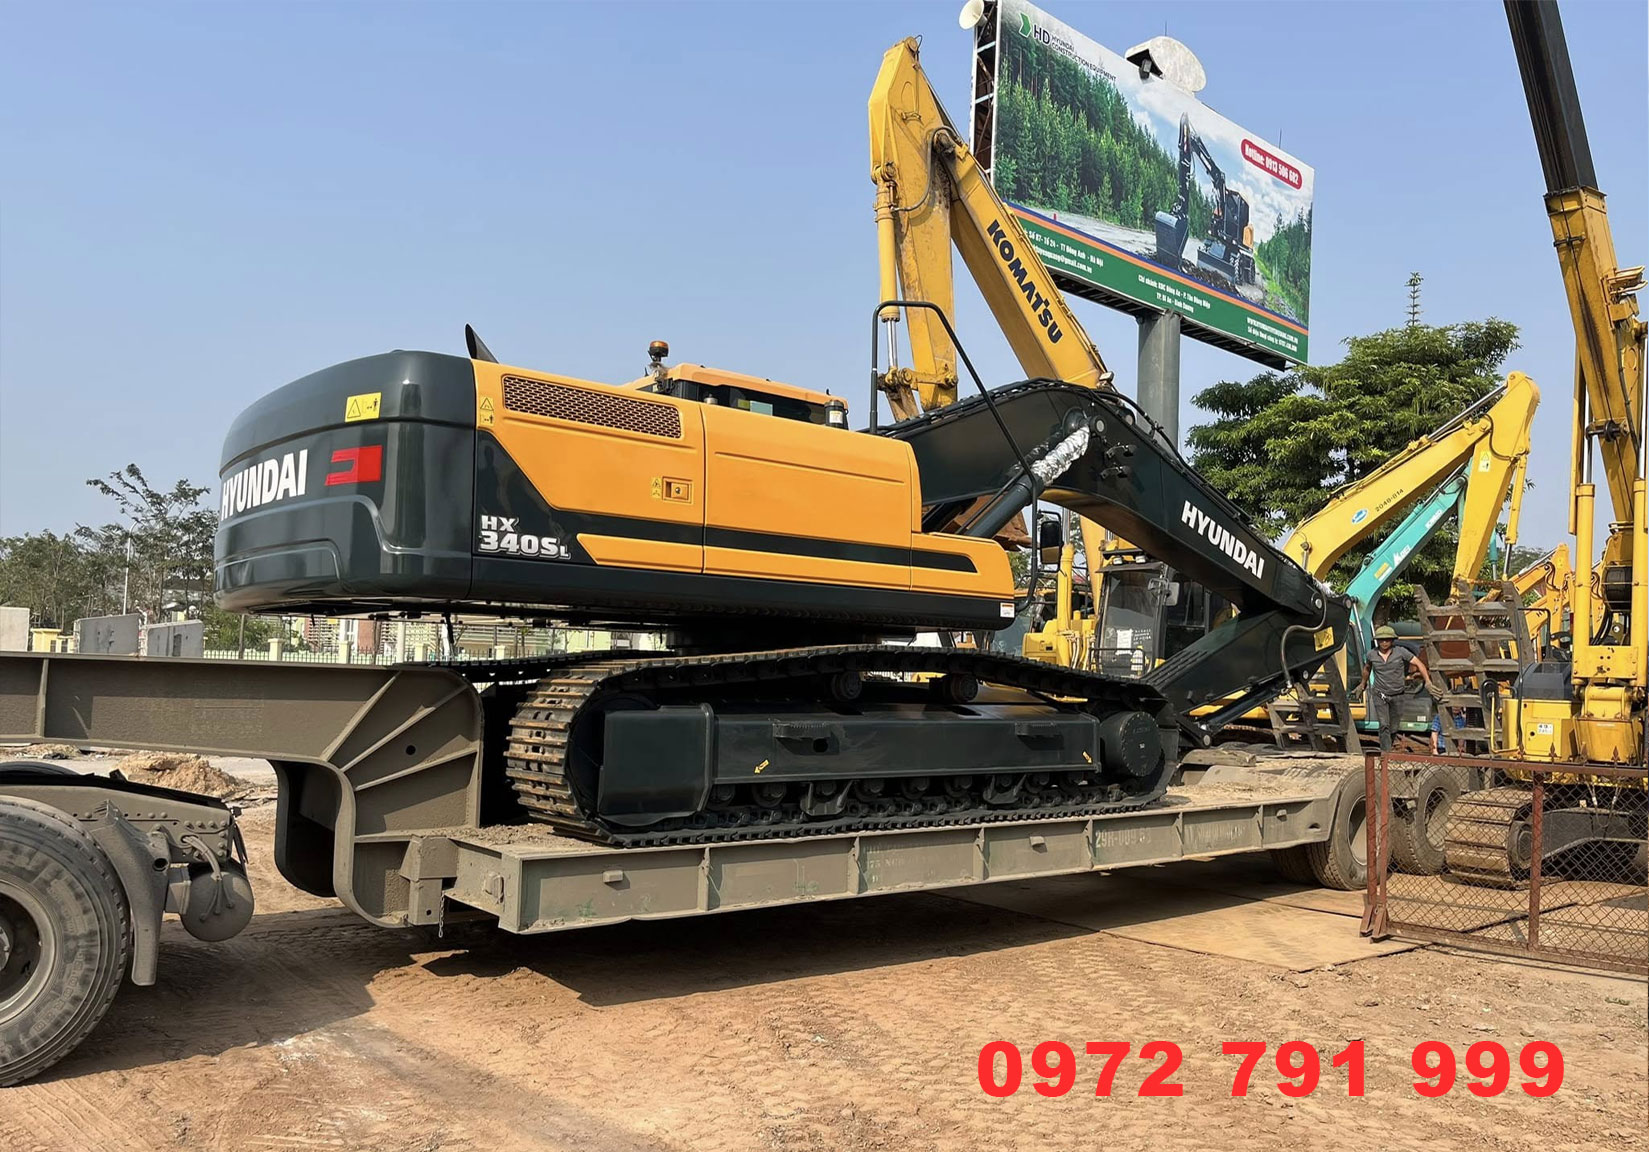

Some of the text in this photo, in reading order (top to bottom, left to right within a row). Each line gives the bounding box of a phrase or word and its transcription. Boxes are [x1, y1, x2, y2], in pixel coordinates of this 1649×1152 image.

[1033, 24, 1051, 45] HD
[1052, 34, 1075, 51] HYUNDAI
[1052, 42, 1117, 81] CONSTRUCTION EQUIPMENT
[987, 219, 1063, 344] KOMATSU
[220, 448, 308, 522] HYUNDAI
[481, 514, 517, 532] HX
[1181, 500, 1265, 580] HYUNDAI
